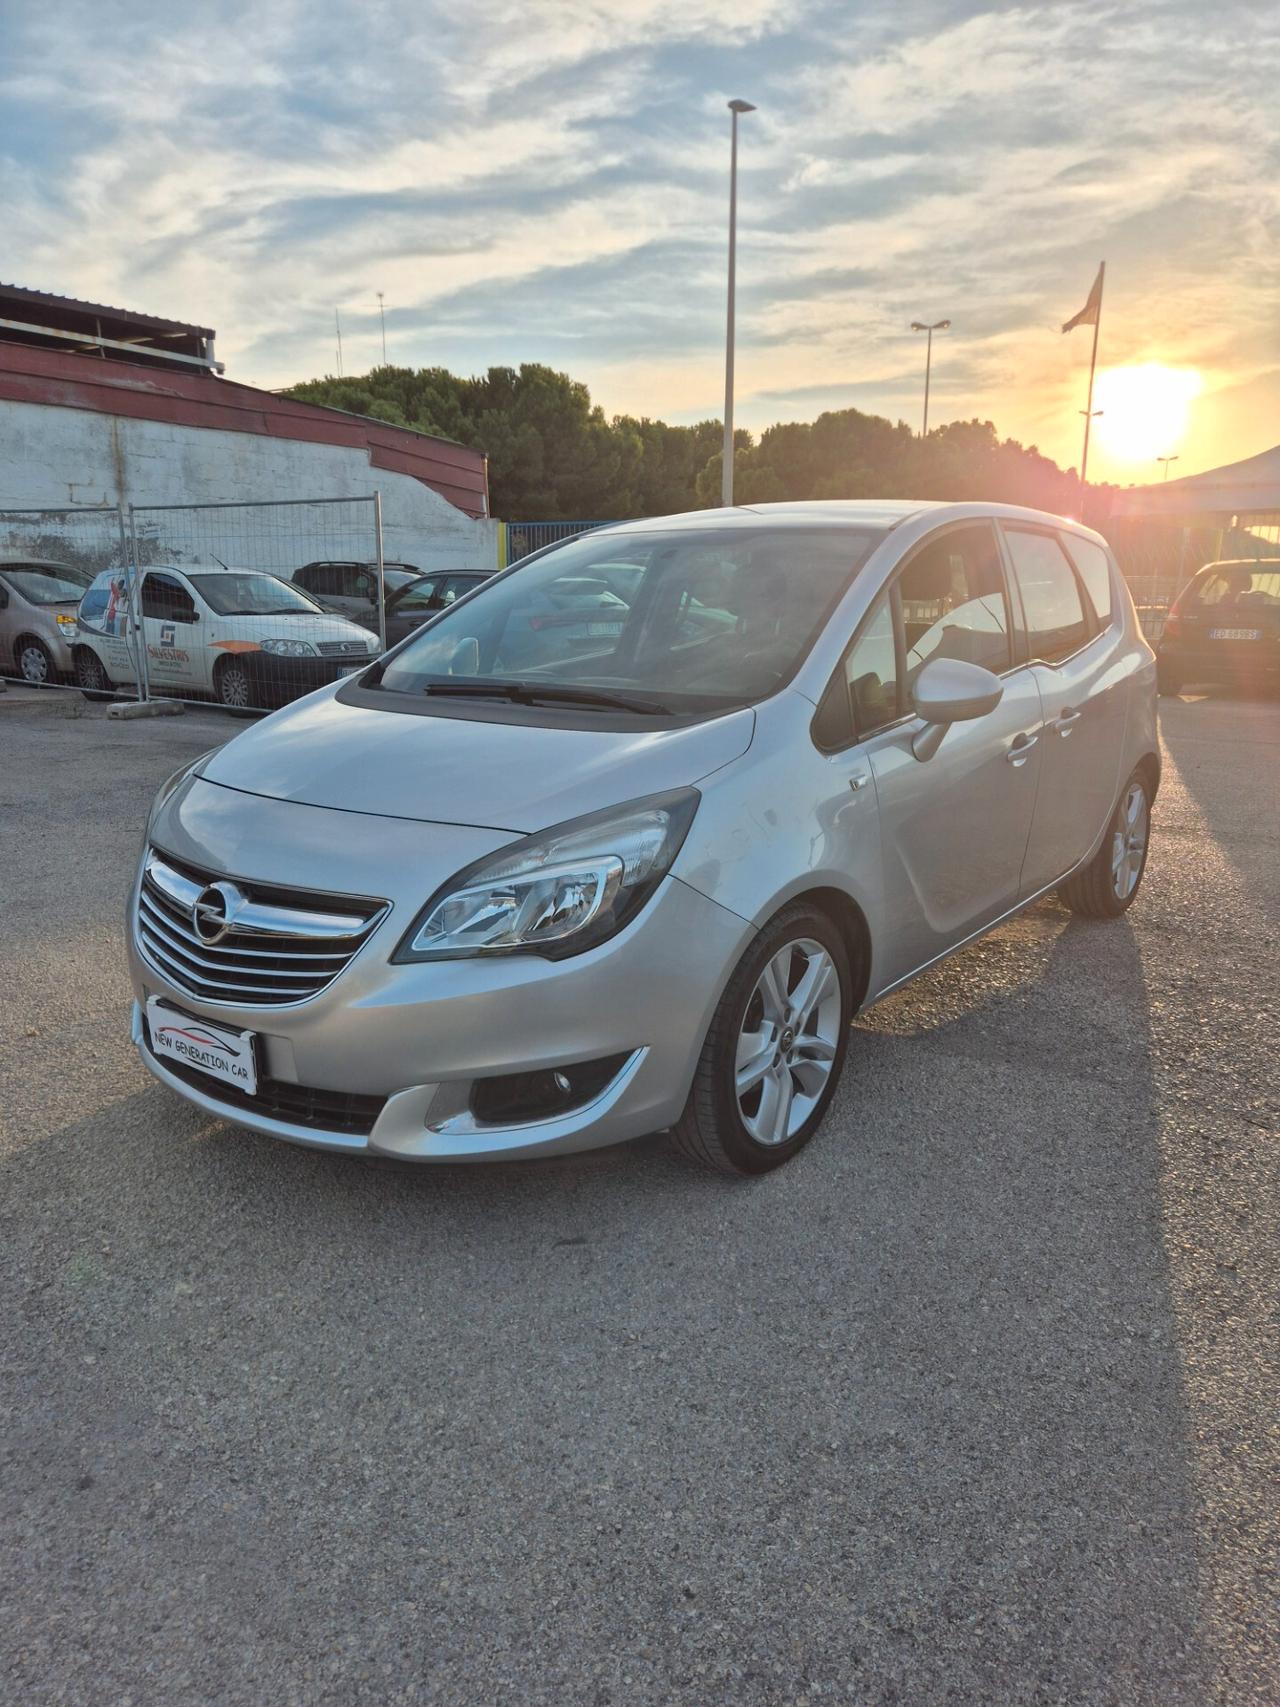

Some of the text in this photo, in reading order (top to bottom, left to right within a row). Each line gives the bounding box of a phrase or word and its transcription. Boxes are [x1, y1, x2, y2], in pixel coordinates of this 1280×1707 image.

[154, 1031, 249, 1080] NEW GENERATION CAR
